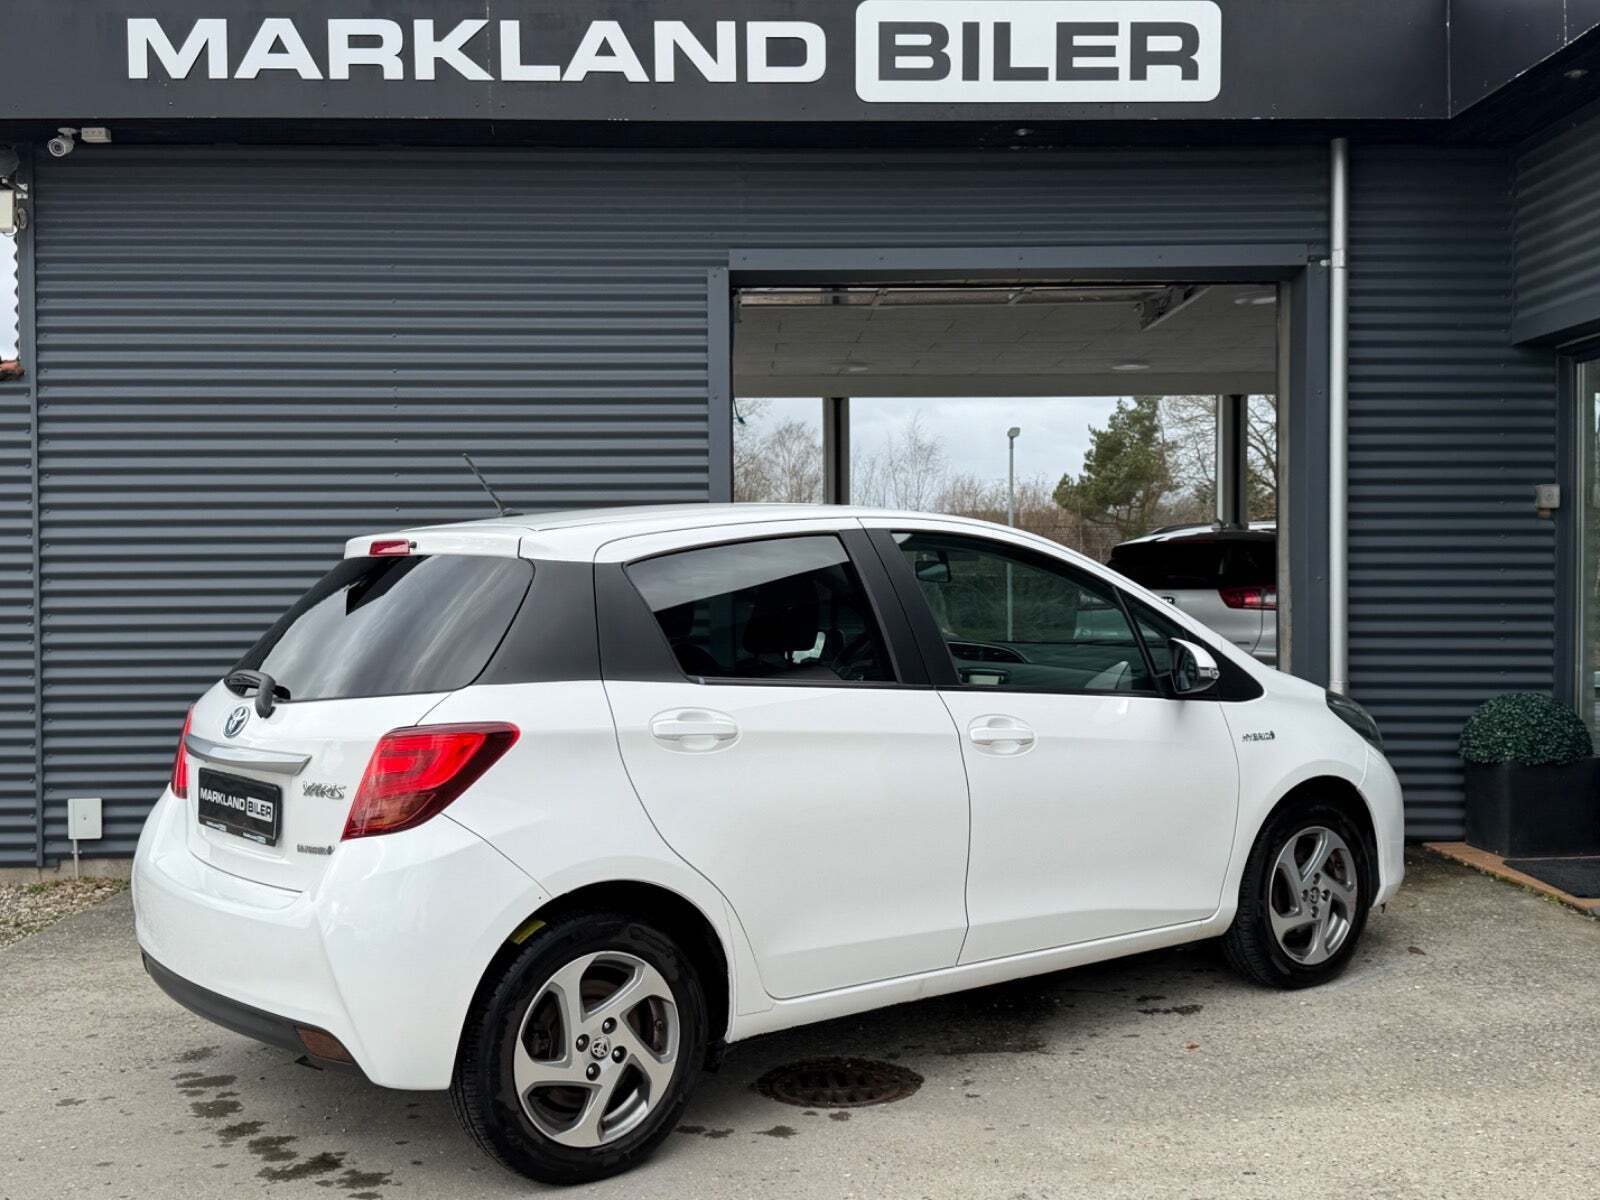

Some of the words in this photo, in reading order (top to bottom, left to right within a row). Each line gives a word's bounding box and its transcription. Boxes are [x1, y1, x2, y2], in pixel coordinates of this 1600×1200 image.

[126, 17, 827, 83] MARKLAND
[877, 21, 1199, 82] BILER
[200, 787, 246, 811] MARKLAND
[248, 800, 272, 818] BILER
